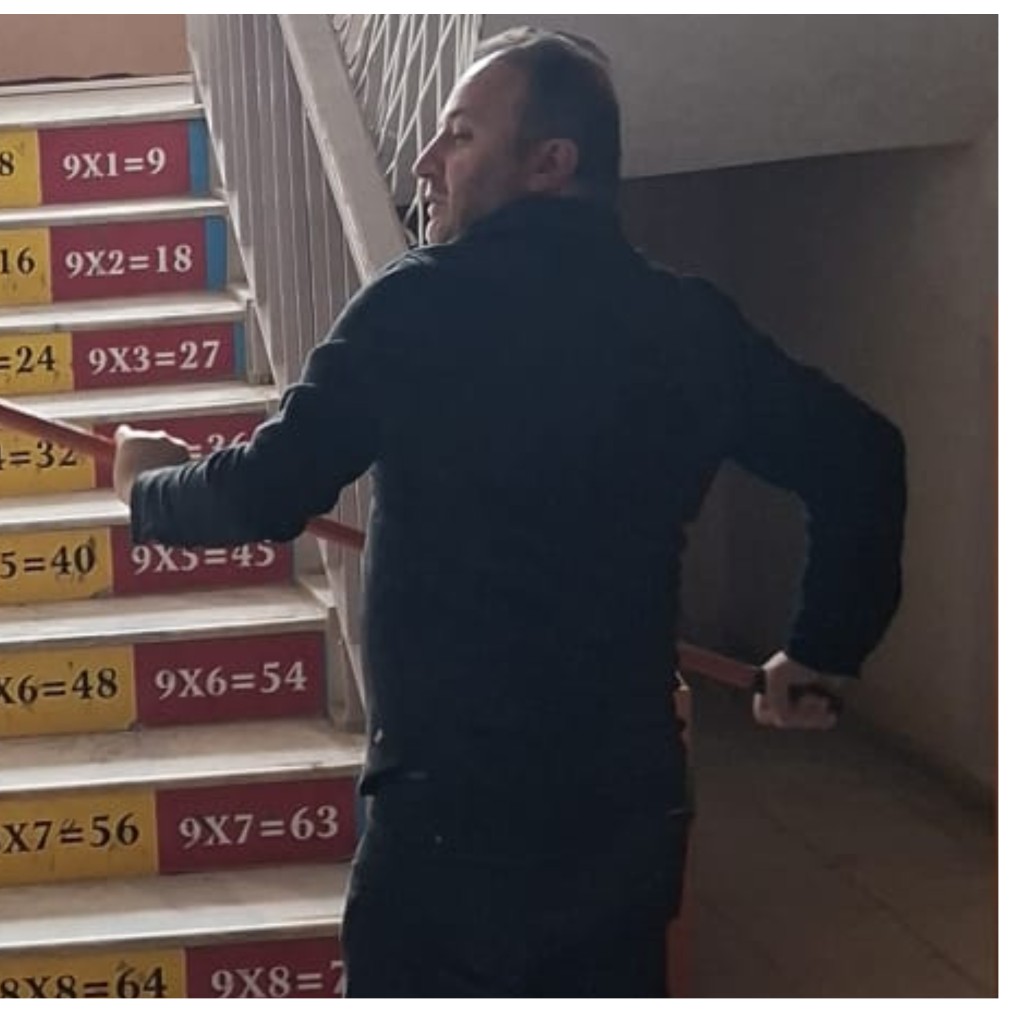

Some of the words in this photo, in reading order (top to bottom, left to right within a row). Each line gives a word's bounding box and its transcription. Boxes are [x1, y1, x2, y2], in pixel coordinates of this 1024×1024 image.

[62, 146, 166, 181] 9X1=9
[65, 244, 193, 279] 9X2=18
[88, 340, 221, 375] 9X3=27
[130, 539, 276, 576] 9X5=45
[154, 660, 308, 701] 9X6=54
[179, 804, 339, 849] 9X7=63
[0, 964, 167, 998] 8X8=64
